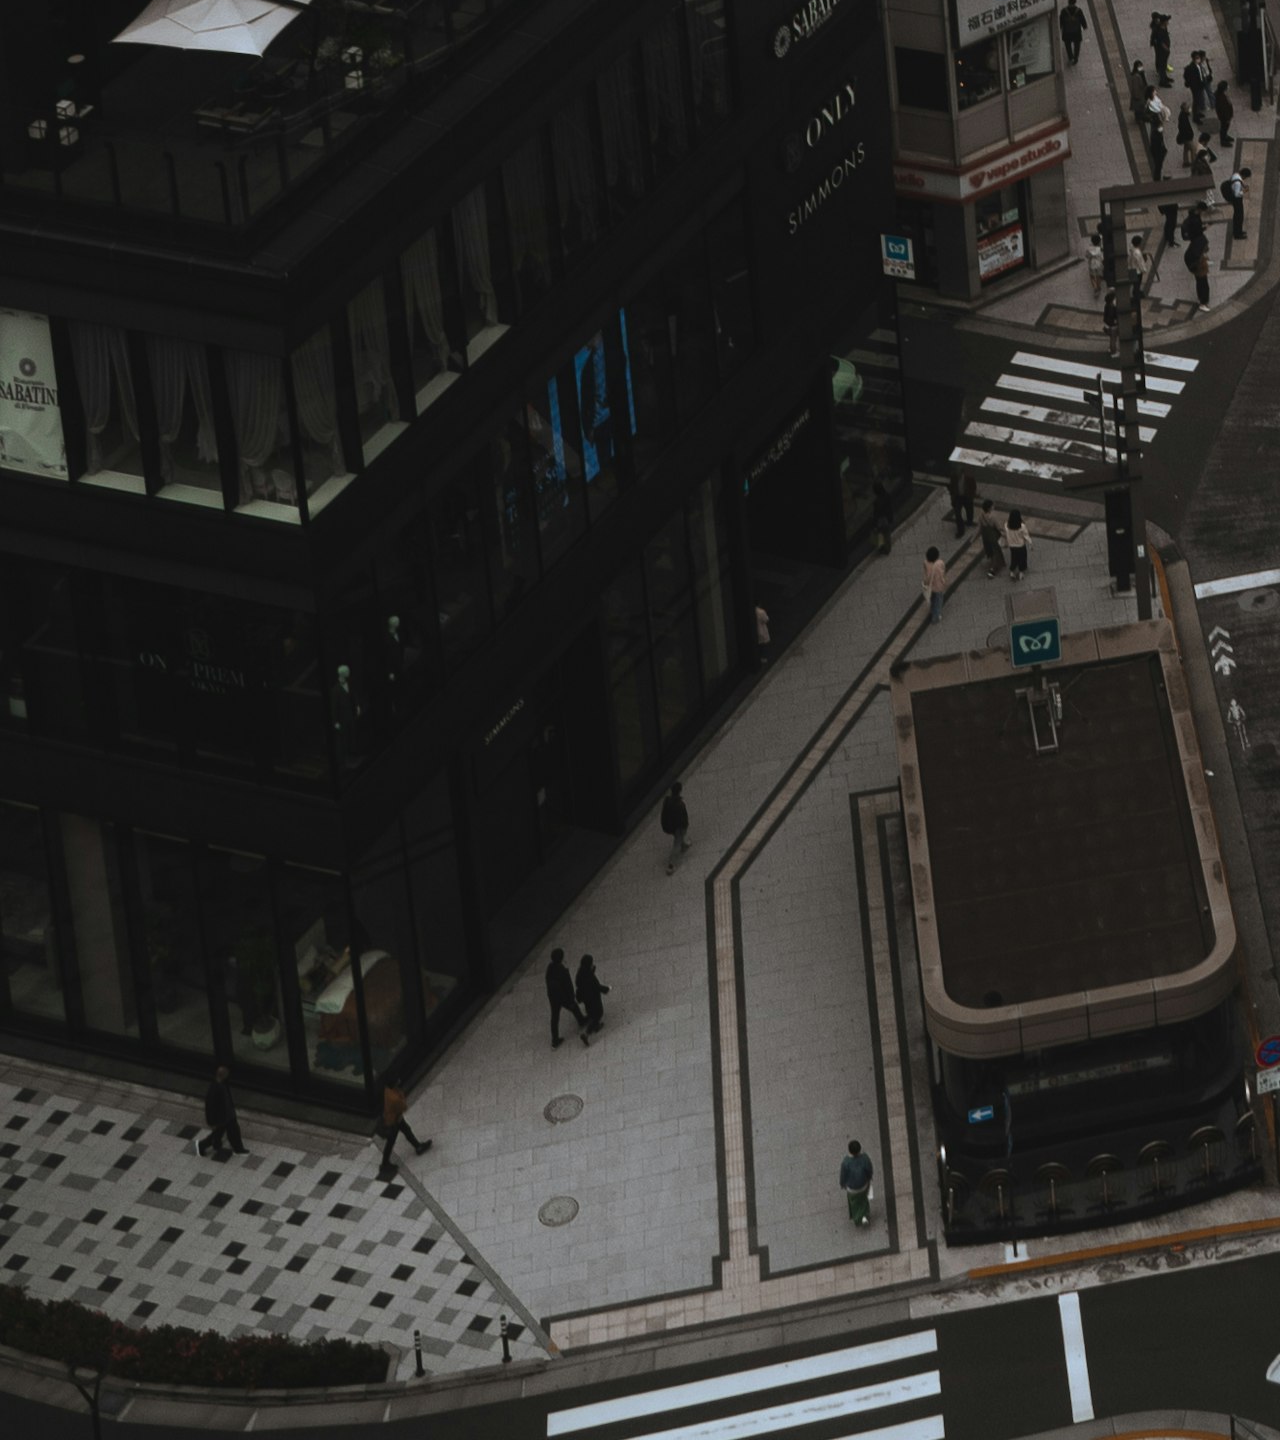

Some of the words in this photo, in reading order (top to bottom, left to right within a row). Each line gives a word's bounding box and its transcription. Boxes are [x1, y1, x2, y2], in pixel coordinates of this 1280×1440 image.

[806, 75, 858, 148] ONLY
[788, 141, 865, 235] SIMMONS
[984, 157, 1019, 181] vape
[1019, 138, 1062, 167] studio
